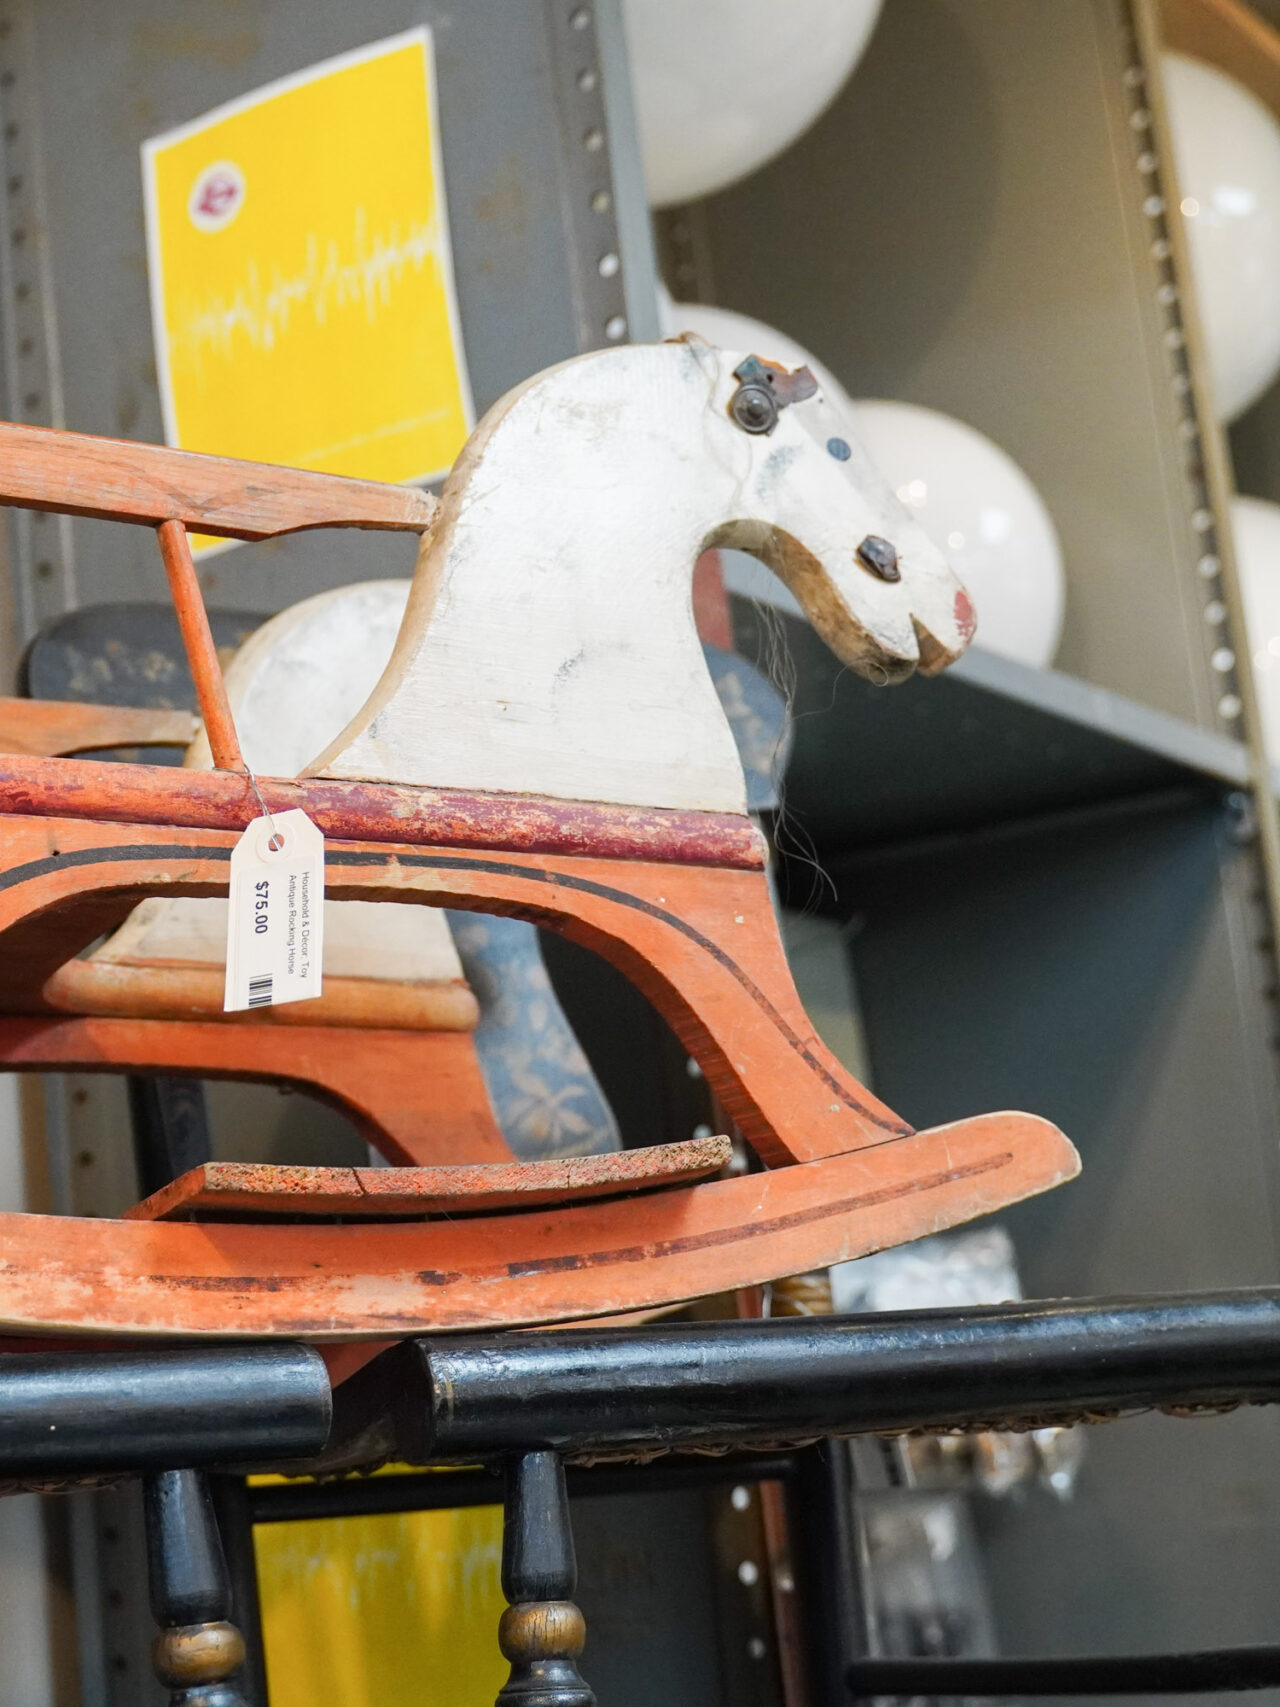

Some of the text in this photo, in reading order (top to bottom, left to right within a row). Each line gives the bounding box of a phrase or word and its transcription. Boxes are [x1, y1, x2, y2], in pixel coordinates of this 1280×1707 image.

[254, 881, 269, 934] $75.00
[302, 872, 310, 918] Household
[286, 875, 297, 974] Antique Rocking Horse
[300, 961, 309, 978] Toy
